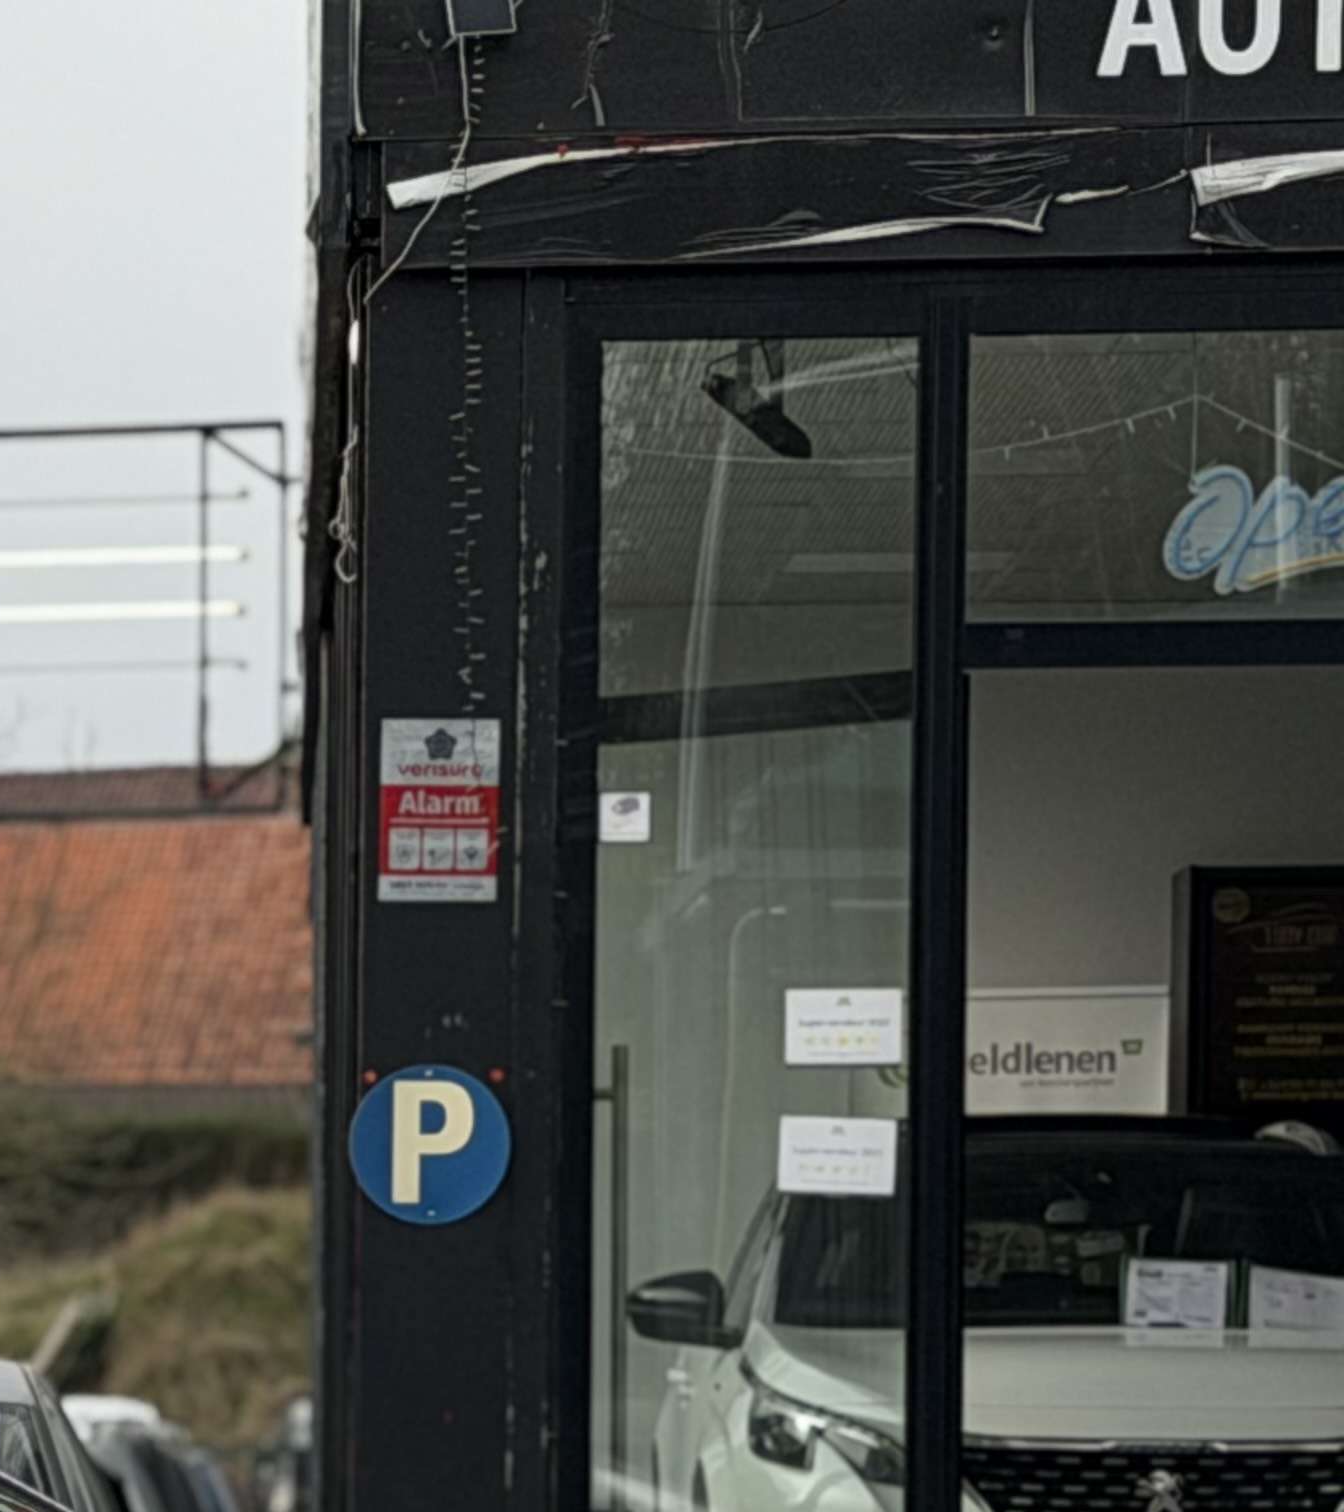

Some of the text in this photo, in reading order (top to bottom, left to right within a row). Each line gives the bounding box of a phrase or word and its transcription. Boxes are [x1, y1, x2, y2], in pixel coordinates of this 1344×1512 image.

[398, 789, 481, 815] Alarm
[969, 1042, 1117, 1076] eldlenen
[391, 1079, 474, 1204] P
